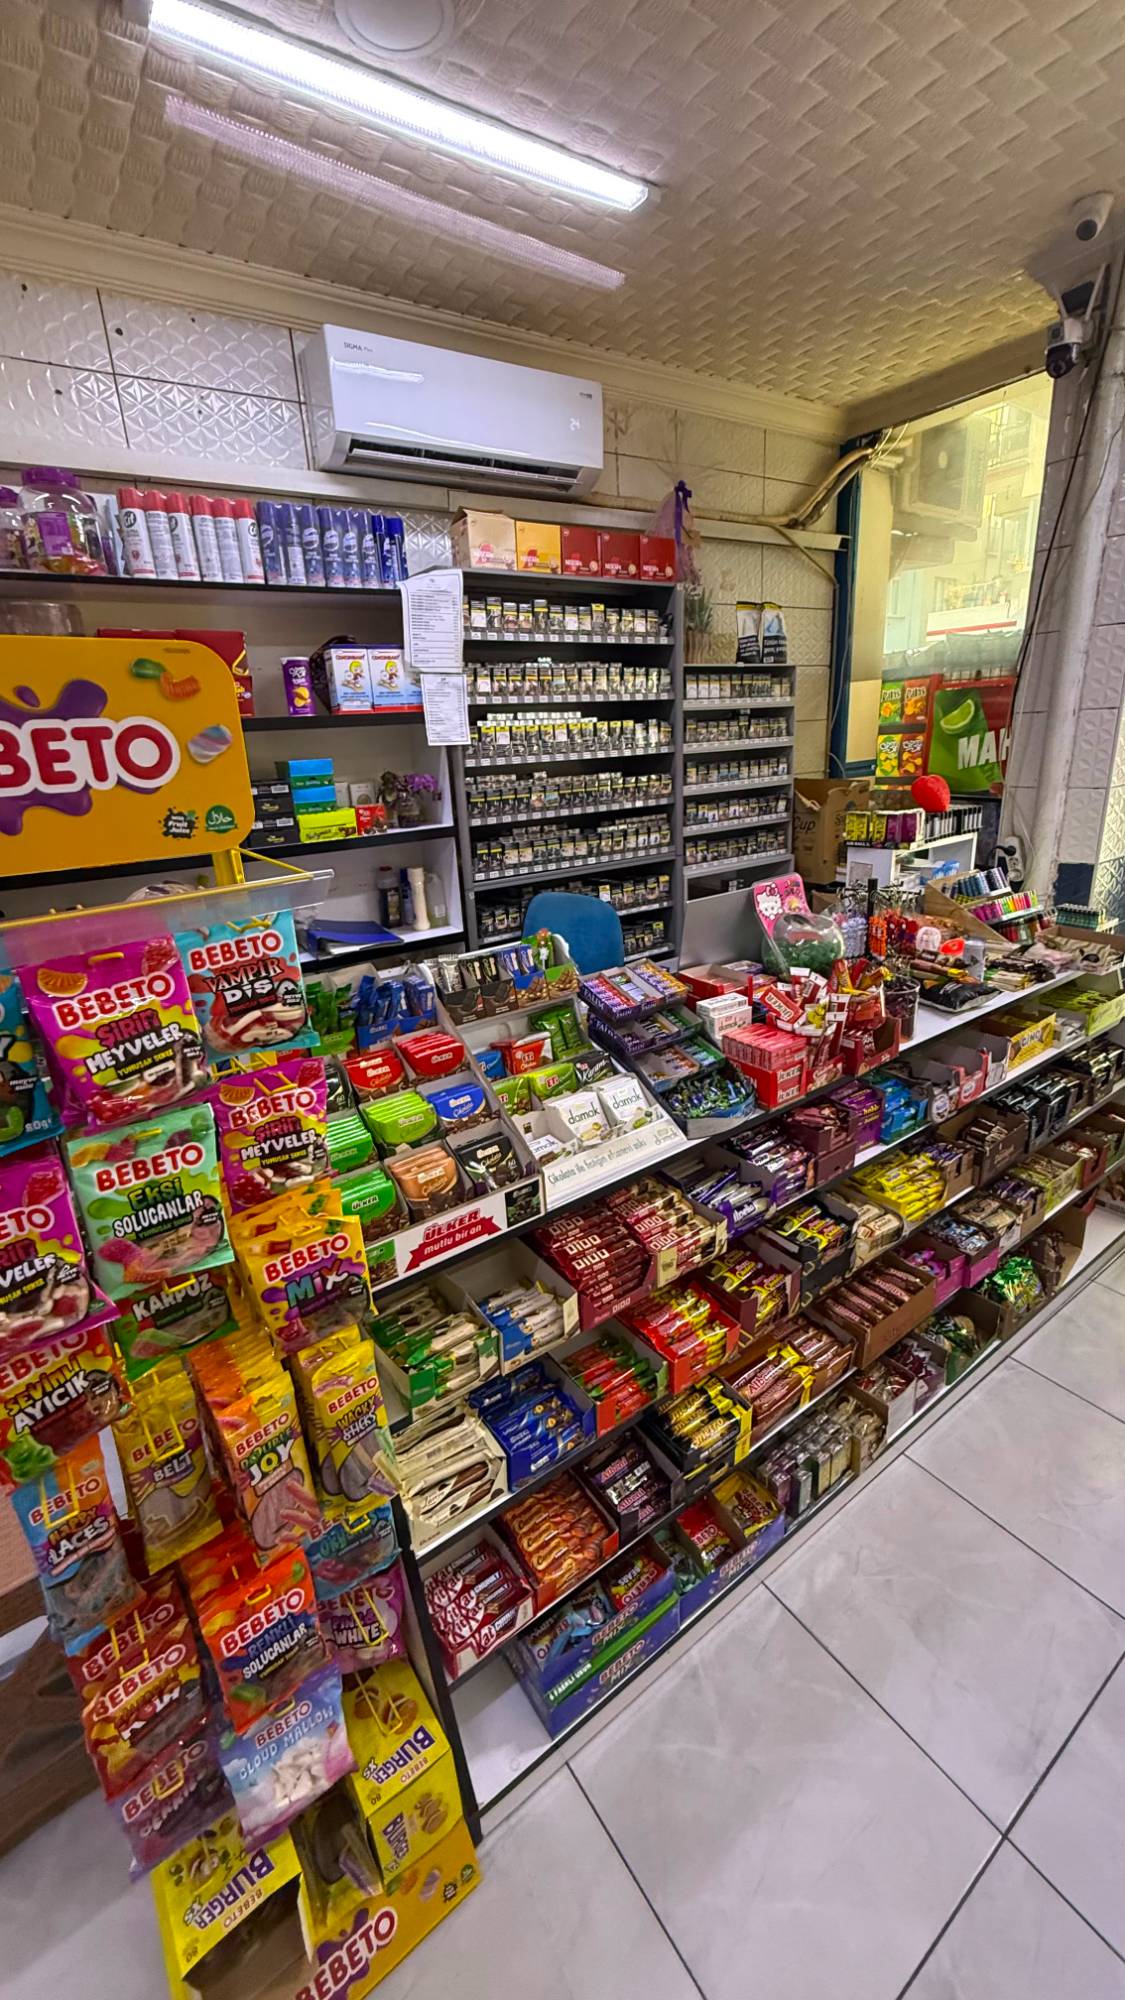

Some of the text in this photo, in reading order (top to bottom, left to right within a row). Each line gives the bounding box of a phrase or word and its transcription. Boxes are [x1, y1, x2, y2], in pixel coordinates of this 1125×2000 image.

[569, 418, 580, 431] 24
[189, 931, 282, 971] BEBETO
[55, 973, 173, 1029] BEBETO
[85, 1023, 183, 1074] MEYVELER
[231, 1091, 315, 1128] BEBETO
[241, 1129, 317, 1160] MEYVELER
[96, 1143, 204, 1192] BEBETO
[113, 1191, 203, 1238] SOLUCANLAR
[351, 1195, 379, 1210] ÜLKER
[423, 1208, 480, 1242] ÜLKER
[423, 1225, 482, 1255] mutlu bir an
[564, 1234, 602, 1255] DIDO
[265, 1235, 349, 1282] BEBETO
[571, 1249, 610, 1271] DIDO
[14, 1370, 91, 1434] AYICIK
[328, 1377, 377, 1413] BEBETO
[236, 1413, 289, 1456] BEBETO
[153, 1450, 193, 1482] BELT
[251, 1440, 293, 1486] JOY
[48, 1517, 110, 1566] LACES
[474, 1569, 501, 1594] CHUNKY
[222, 1590, 304, 1656] BEBETO
[242, 1622, 307, 1679] SOLUCANLAR
[600, 1640, 645, 1683] BEBETO
[95, 1646, 184, 1718] BEBETO
[239, 1705, 334, 1779] CLOUD MALLOW
[256, 1701, 312, 1748] BEBETO
[375, 1726, 435, 1783] BURGER
[400, 1757, 428, 1784] BEBETO
[195, 1849, 275, 1930] BURGER
[223, 1888, 263, 1928] BEBETO
[295, 1909, 396, 2000] BEBETO
